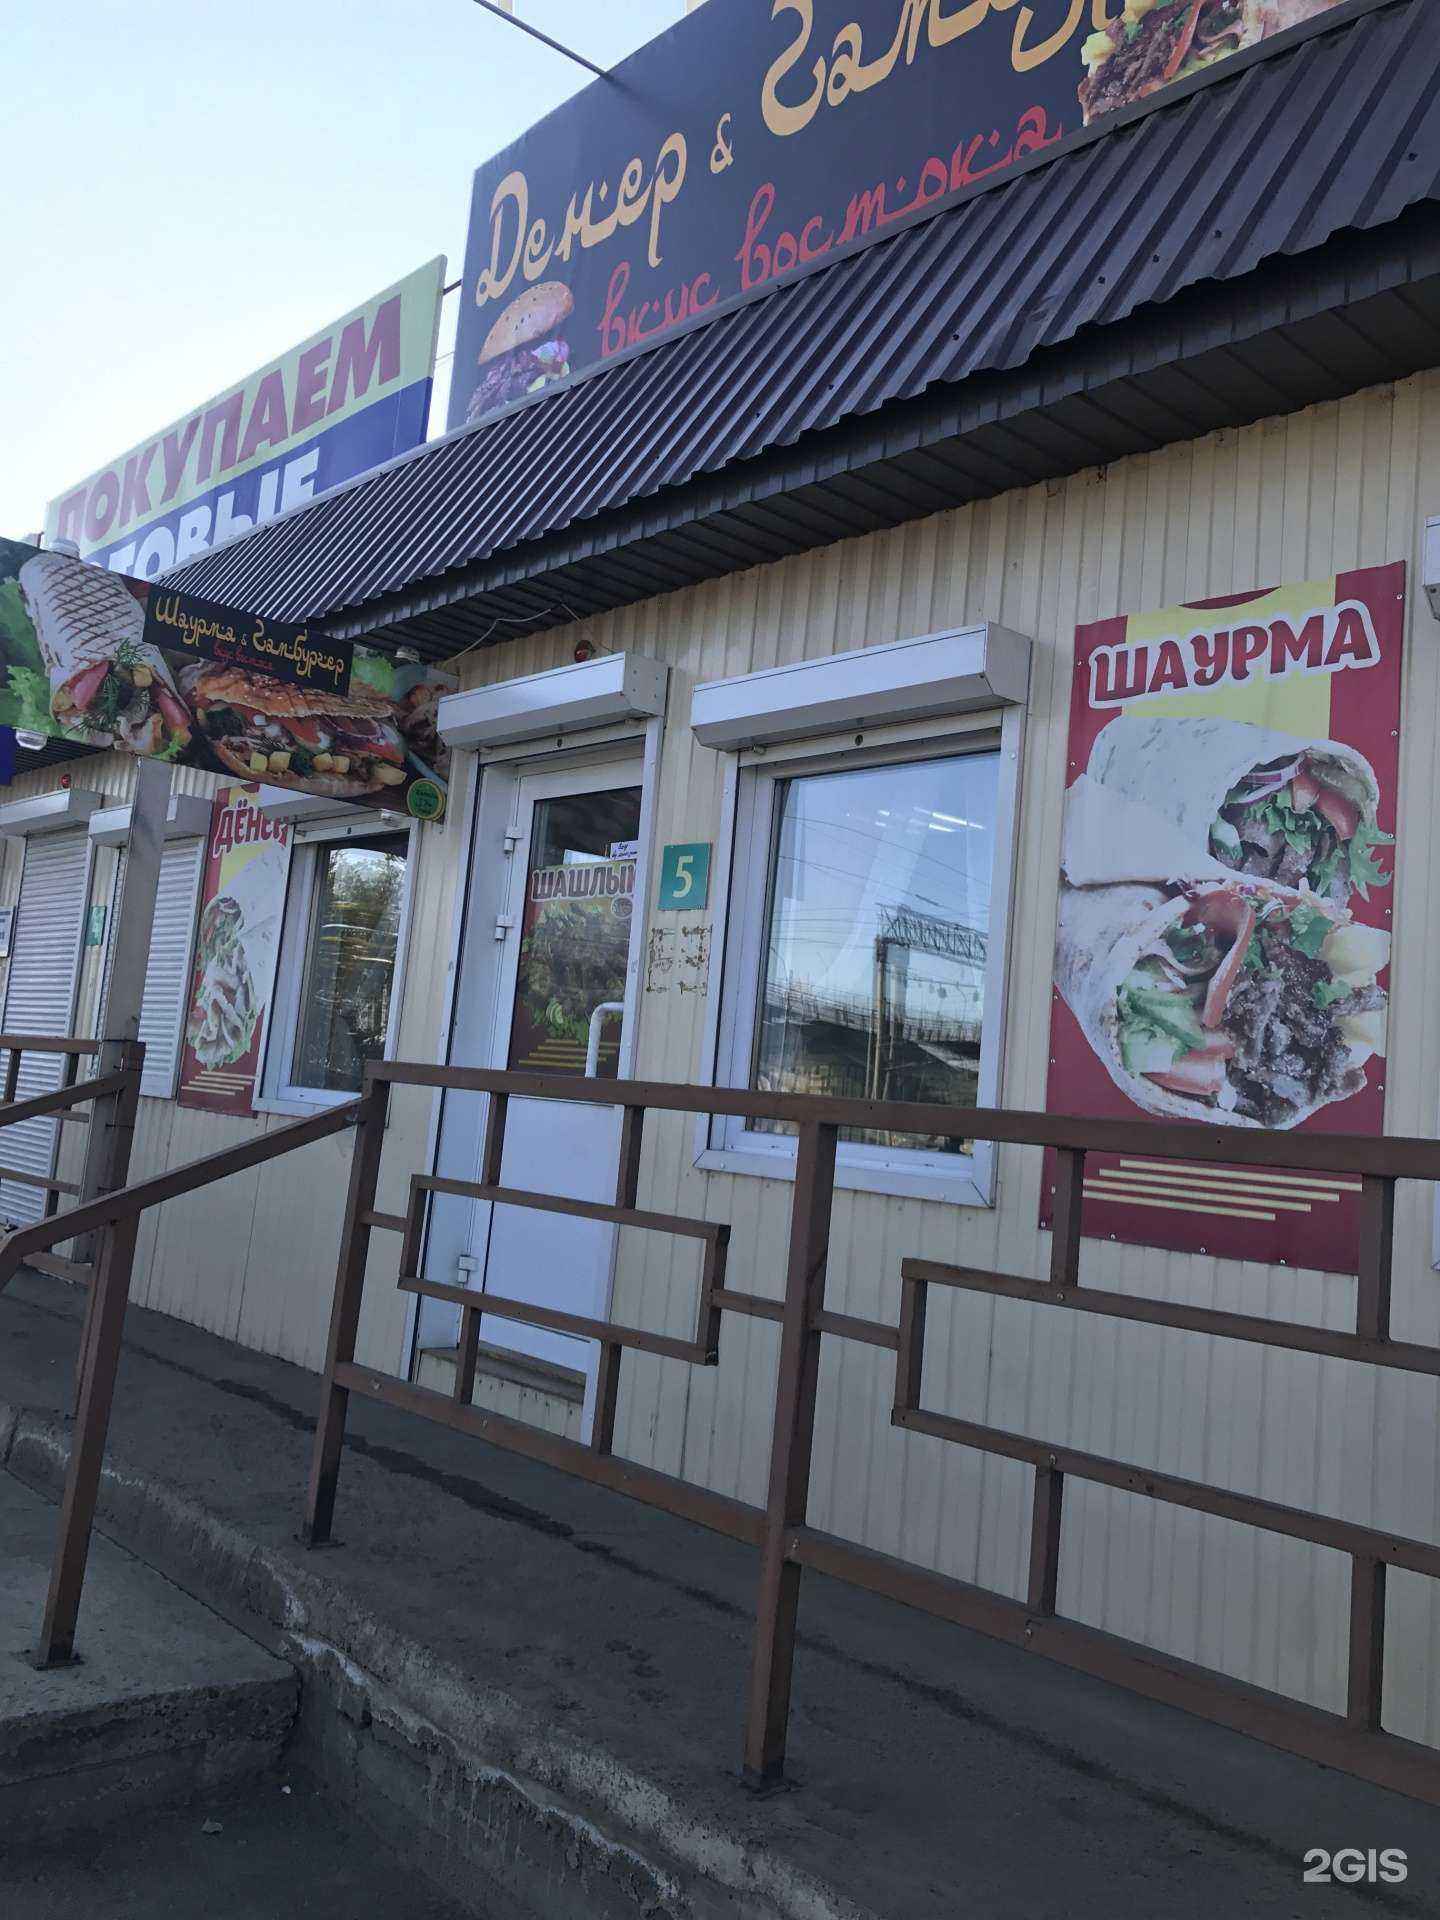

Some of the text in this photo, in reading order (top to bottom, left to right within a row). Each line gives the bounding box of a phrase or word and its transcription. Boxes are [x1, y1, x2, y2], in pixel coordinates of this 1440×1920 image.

[710, 112, 734, 174] &
[56, 293, 402, 547] ПОКУПАЕМ
[155, 595, 236, 647] Шаурма
[252, 618, 345, 686] Гамбургер
[1093, 606, 1374, 703] ШАУРМА
[672, 855, 694, 898] 5
